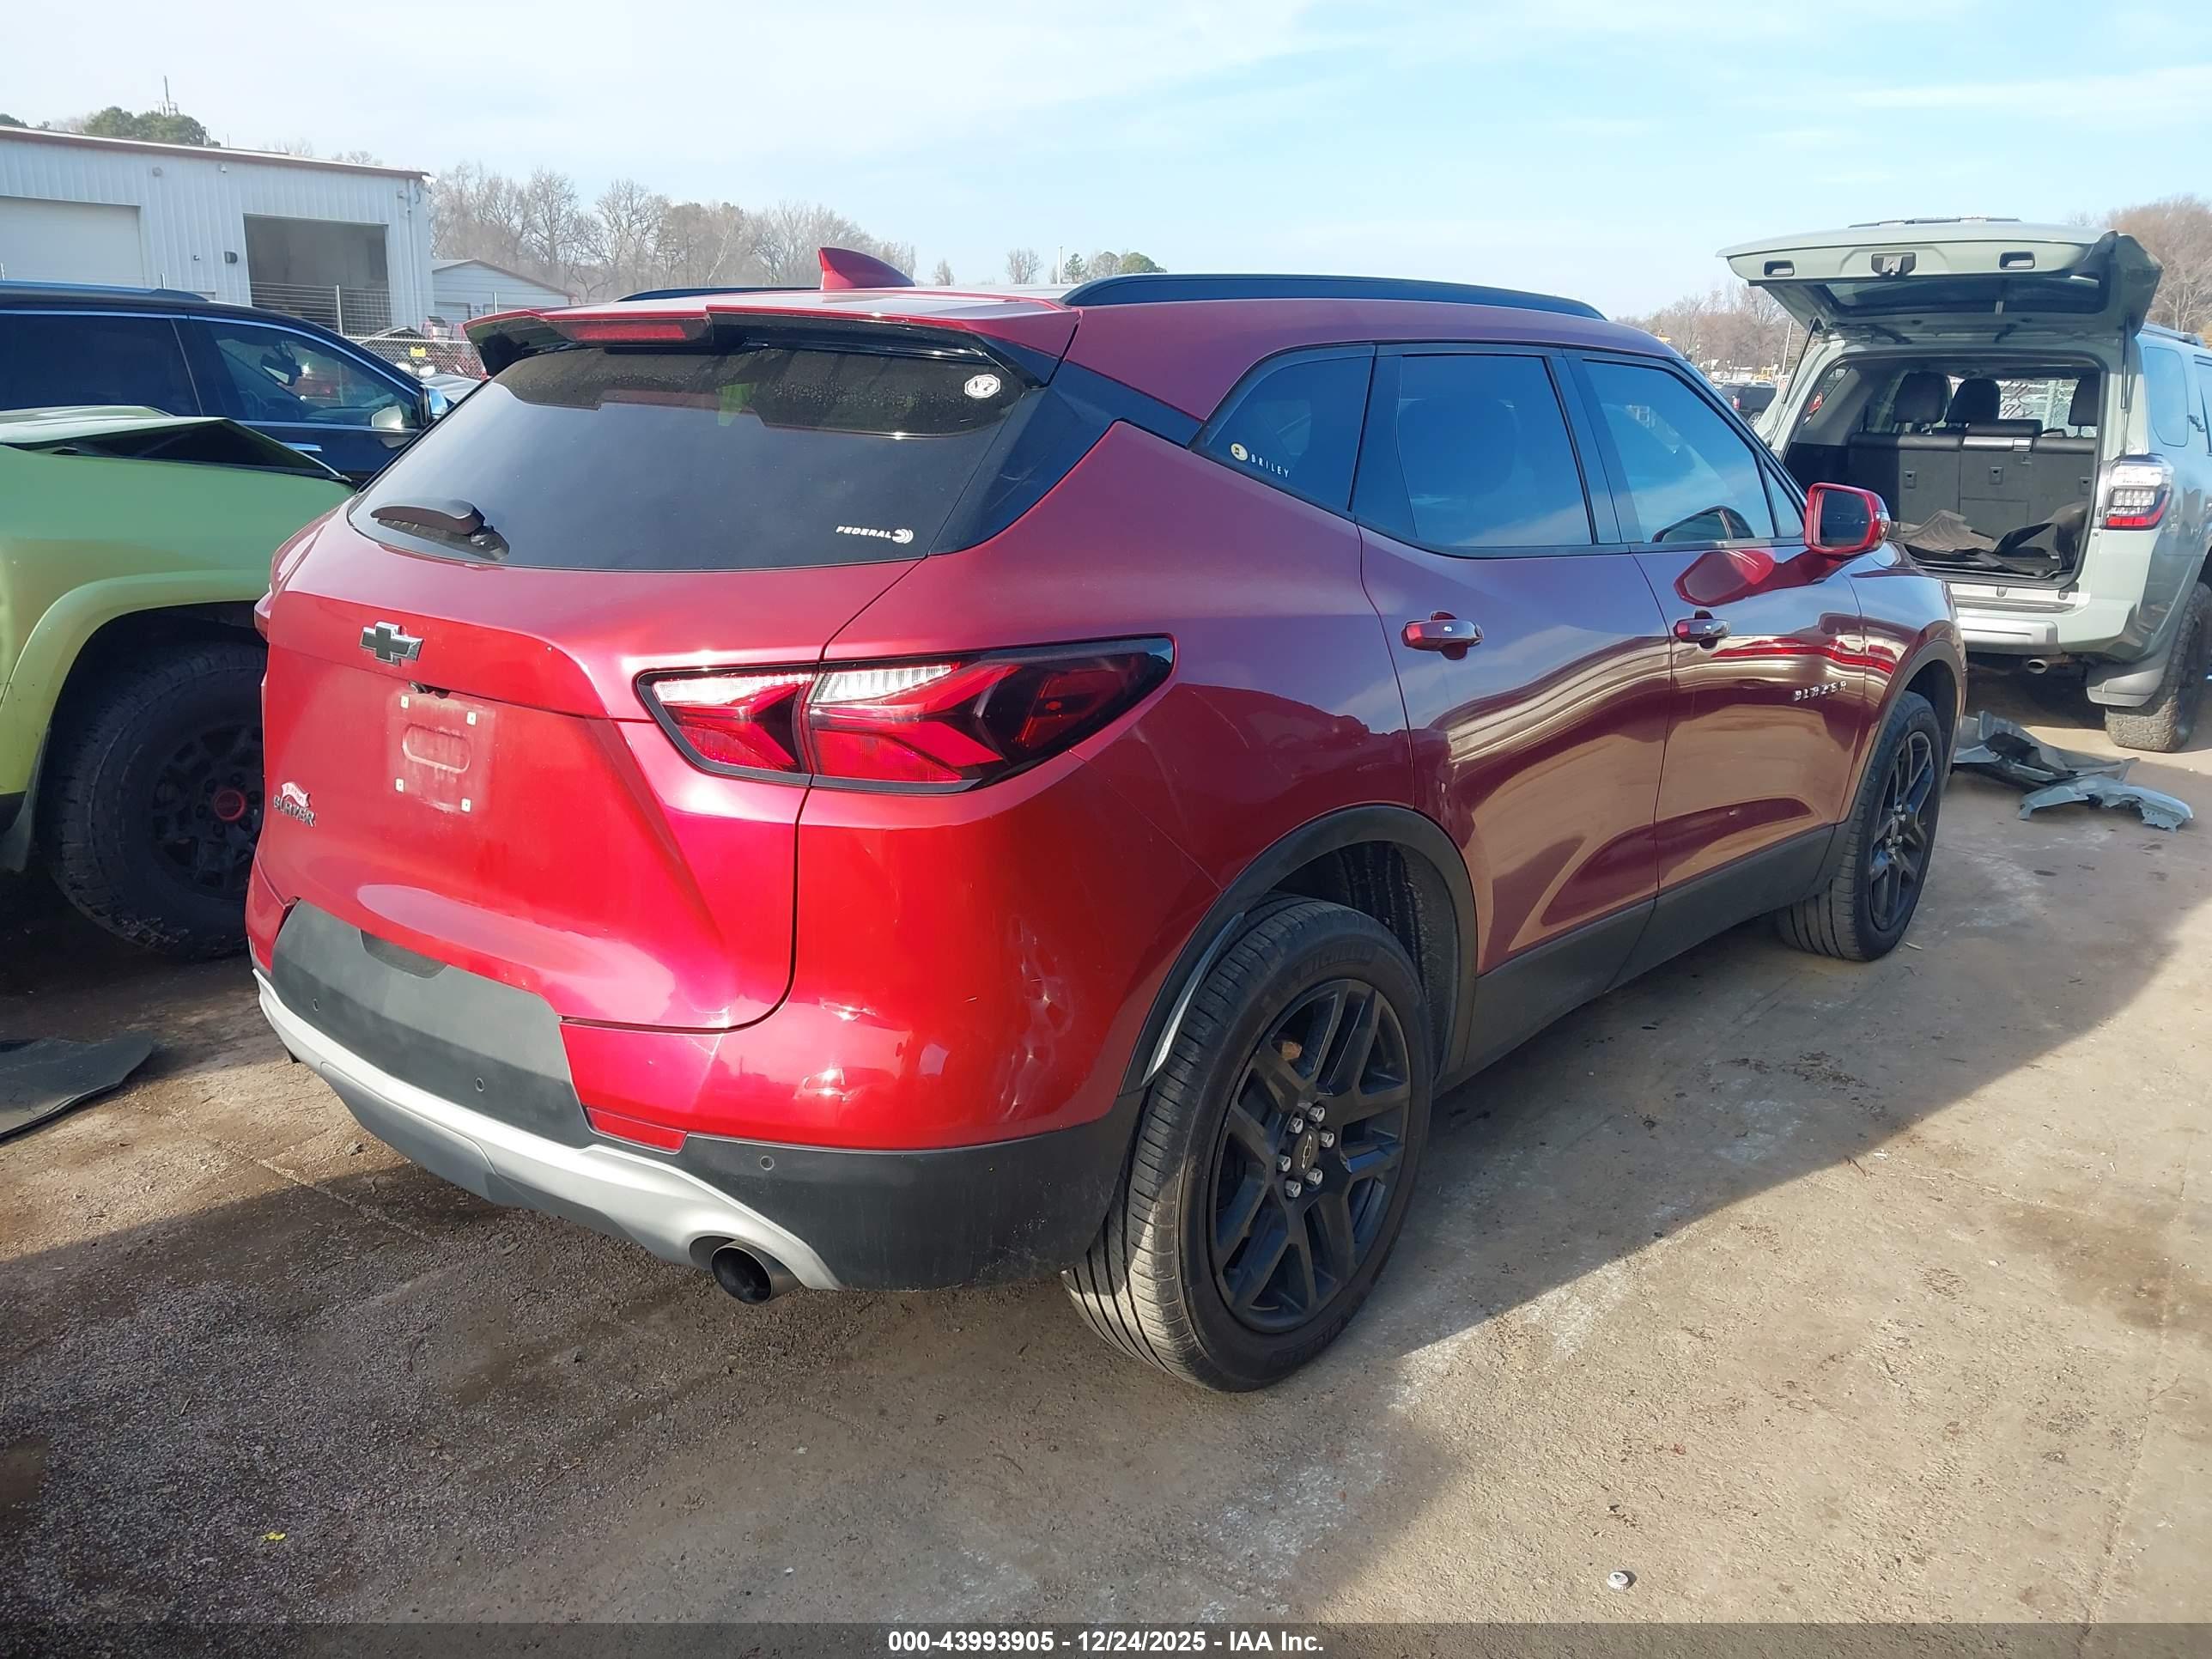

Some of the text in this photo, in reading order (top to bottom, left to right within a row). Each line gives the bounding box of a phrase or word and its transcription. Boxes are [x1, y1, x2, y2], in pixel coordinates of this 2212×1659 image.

[1251, 453, 1290, 478] BRILEY
[836, 526, 891, 538] FEDERAL
[273, 795, 316, 827] BLAZER
